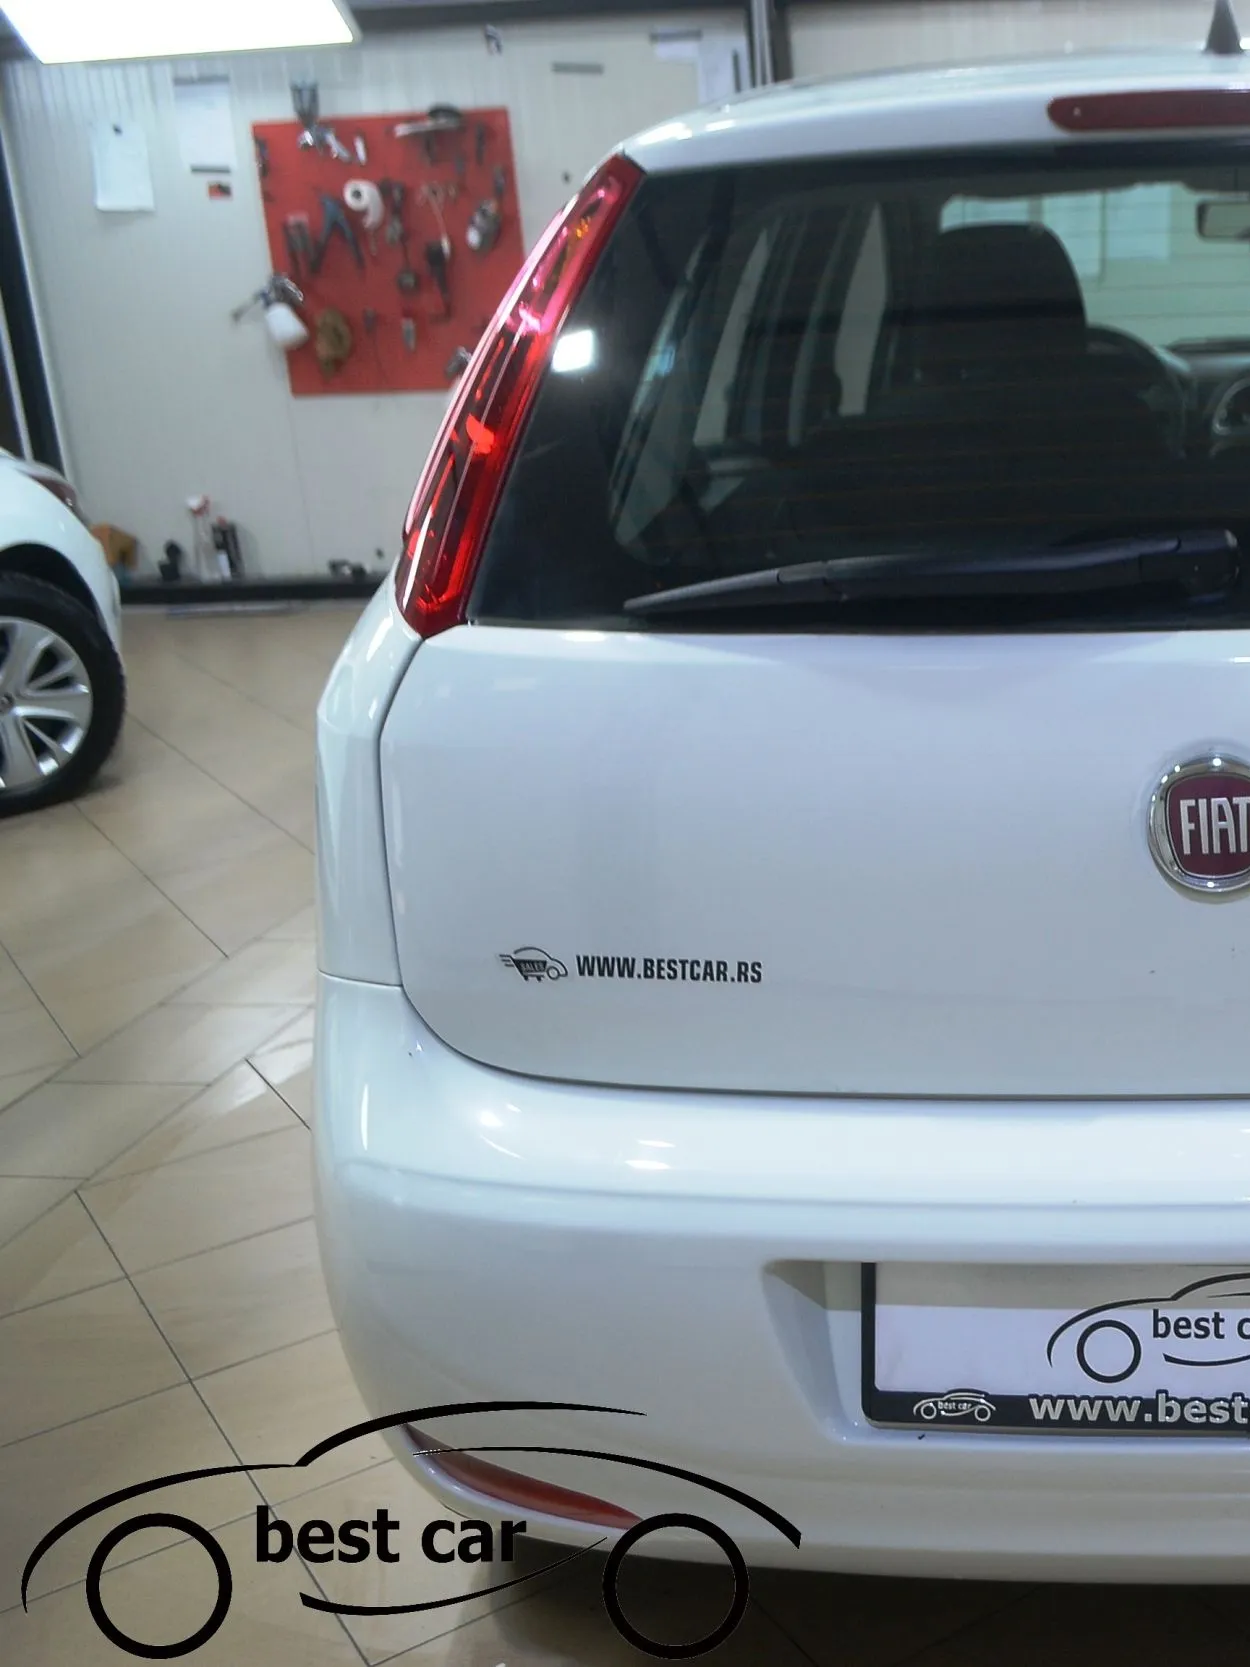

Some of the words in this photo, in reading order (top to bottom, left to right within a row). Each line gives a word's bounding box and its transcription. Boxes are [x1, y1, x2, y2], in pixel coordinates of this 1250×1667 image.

[576, 955, 763, 983] WWW.BESTCAR.RS
[1152, 1309, 1225, 1340] best
[937, 1400, 957, 1410] best
[958, 1402, 972, 1410] car
